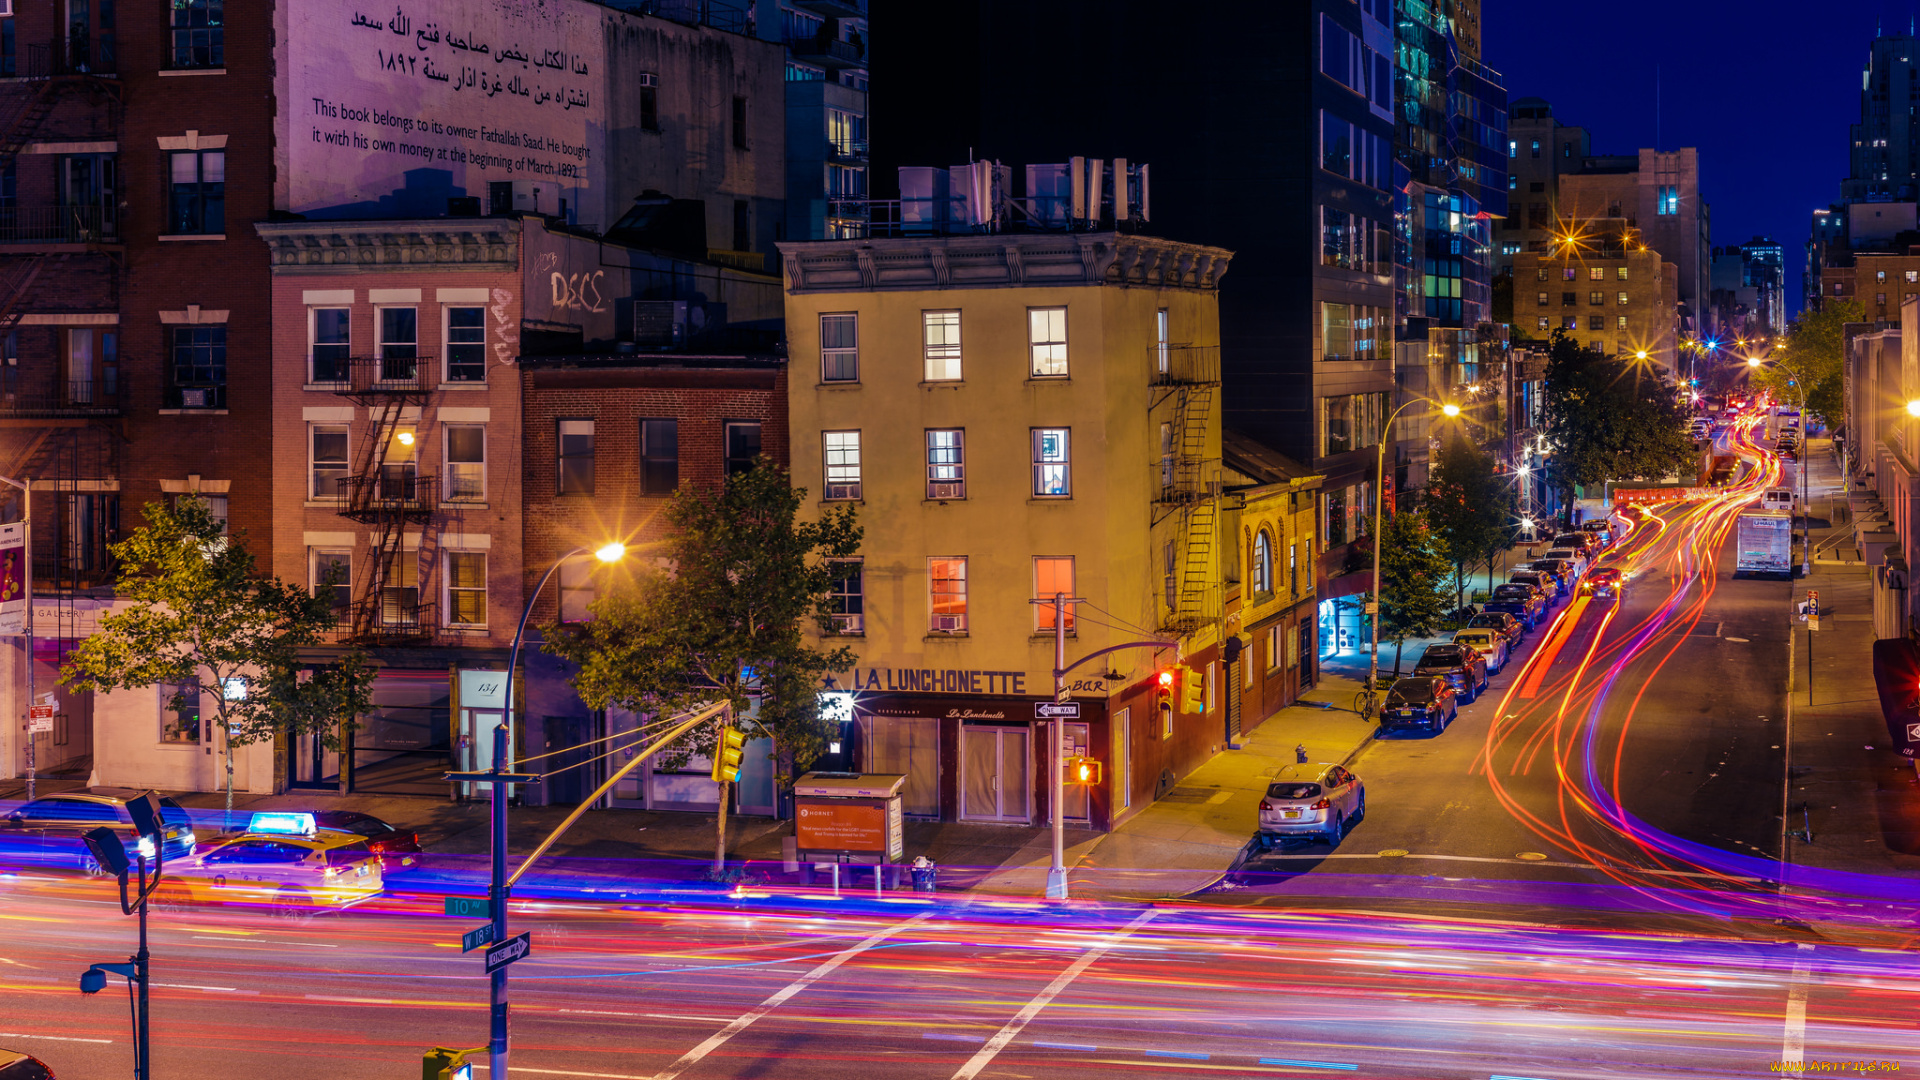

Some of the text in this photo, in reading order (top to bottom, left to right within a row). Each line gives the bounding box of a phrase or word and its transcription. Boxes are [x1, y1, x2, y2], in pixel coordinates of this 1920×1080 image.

[351, 12, 383, 31] سعد
[417, 23, 440, 50] فتح
[445, 31, 489, 54] صاحبه
[495, 44, 528, 68] يخص
[533, 49, 567, 73] الكتاب
[571, 56, 588, 75] هذا
[423, 57, 448, 82] سنة
[453, 67, 476, 90] اذار
[481, 72, 503, 97] غرة
[507, 76, 529, 97] ماله
[534, 87, 550, 104] من
[555, 87, 589, 110] اشتراه
[312, 98, 591, 161] This book belongs to its owner Fathallah Saad. He bought
[313, 126, 320, 142] it
[324, 130, 349, 146] with
[354, 131, 368, 149] his
[372, 140, 395, 153] own
[400, 142, 434, 162] money
[437, 148, 447, 160] at
[450, 147, 466, 162] the
[469, 149, 512, 173] beginning
[515, 157, 525, 171] of
[527, 158, 554, 175] March
[478, 683, 498, 694] 134
[855, 669, 1026, 694] LA LUNCHONETTE
[946, 709, 960, 718] La
[454, 900, 480, 914] 10 AV
[465, 926, 492, 950] W 18 ST
[492, 941, 524, 963] ONE WAY
